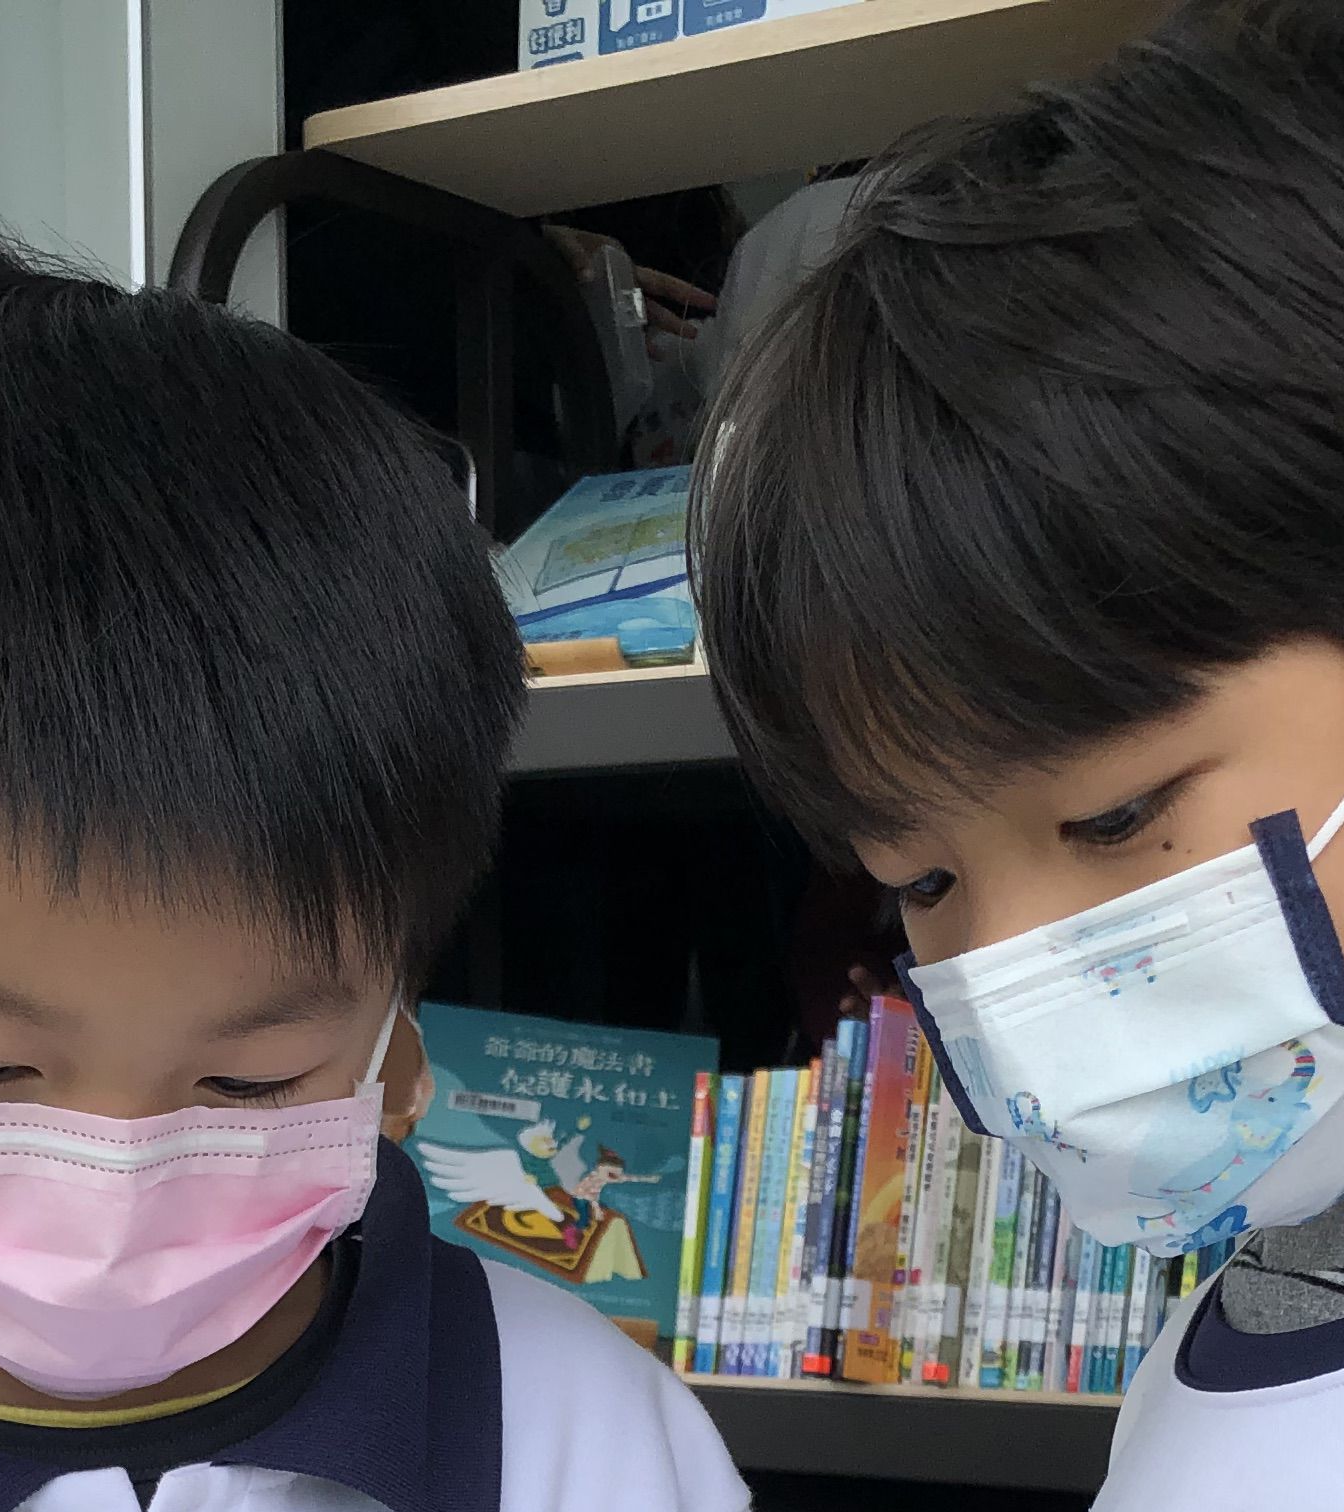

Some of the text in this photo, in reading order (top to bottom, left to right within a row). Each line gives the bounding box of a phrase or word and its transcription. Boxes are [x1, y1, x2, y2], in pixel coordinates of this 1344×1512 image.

[501, 1066, 681, 1111] 保護水和土
